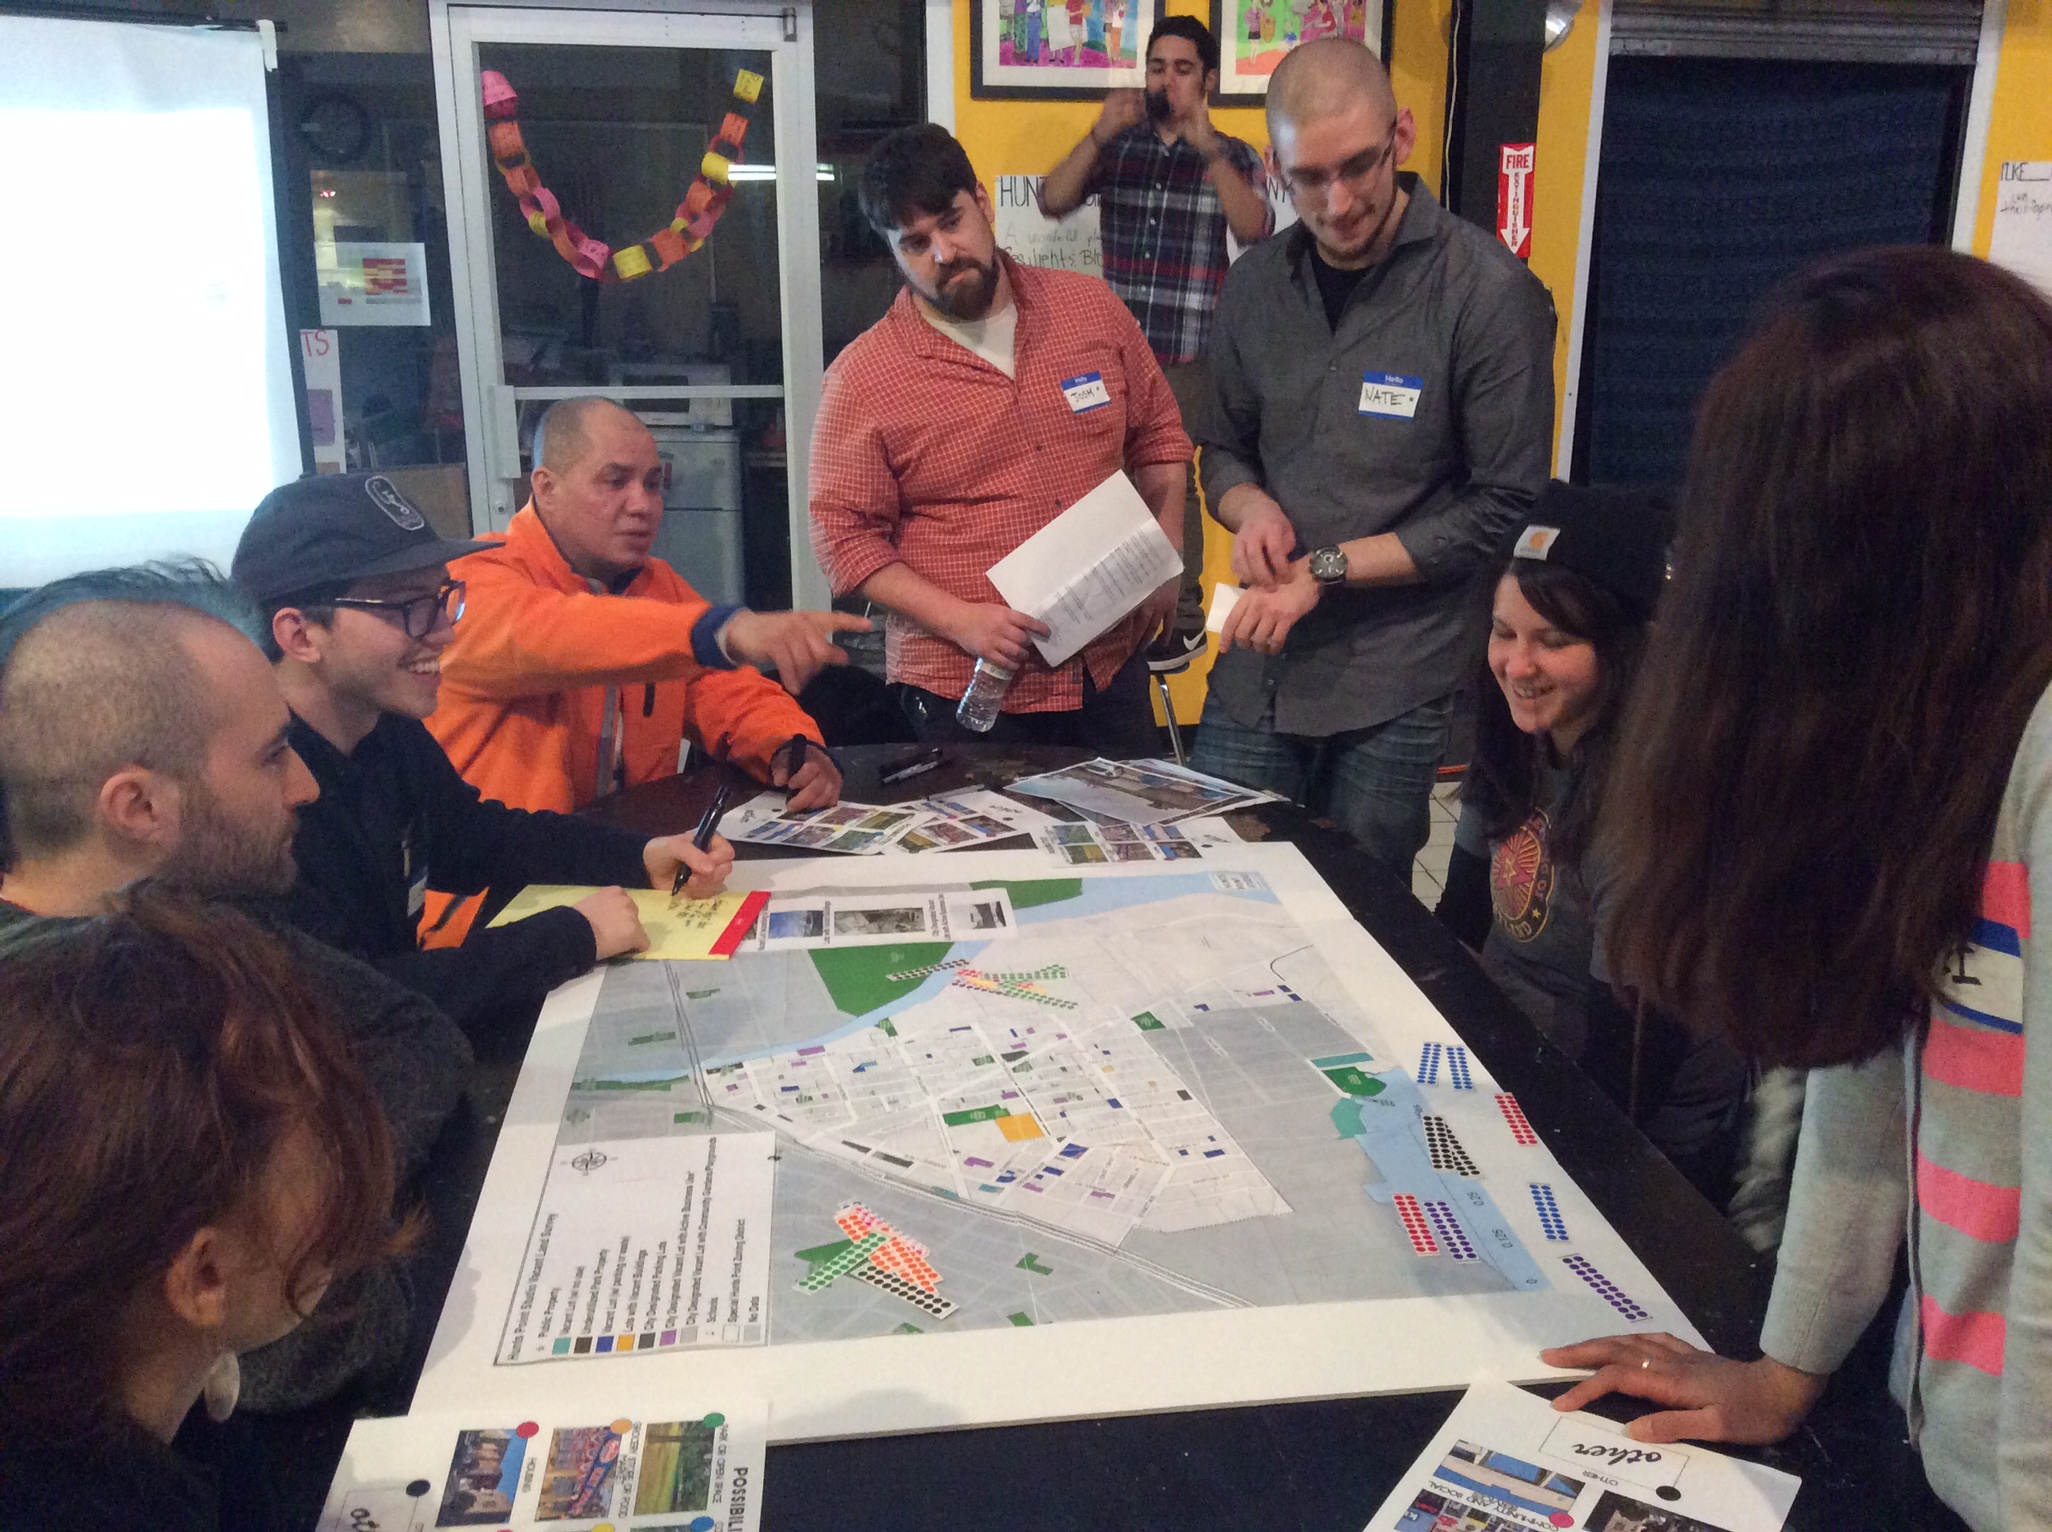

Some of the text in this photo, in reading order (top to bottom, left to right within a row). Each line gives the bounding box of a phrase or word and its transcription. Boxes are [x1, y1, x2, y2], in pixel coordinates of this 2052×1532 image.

[1506, 154, 1529, 169] FIRE
[1511, 172, 1520, 247] EXTINGUISHER
[1385, 374, 1404, 384] Hello
[1070, 387, 1095, 403] JOSH
[1364, 386, 1406, 406] NATE
[748, 1314, 758, 1322] No
[1571, 1442, 1662, 1467] other
[521, 1458, 537, 1492] HOUSING
[716, 1458, 725, 1479] OPEN
[1582, 1470, 1618, 1487] OTHER
[1428, 1481, 1559, 1532] COMMUNITY AND SOCIAL
